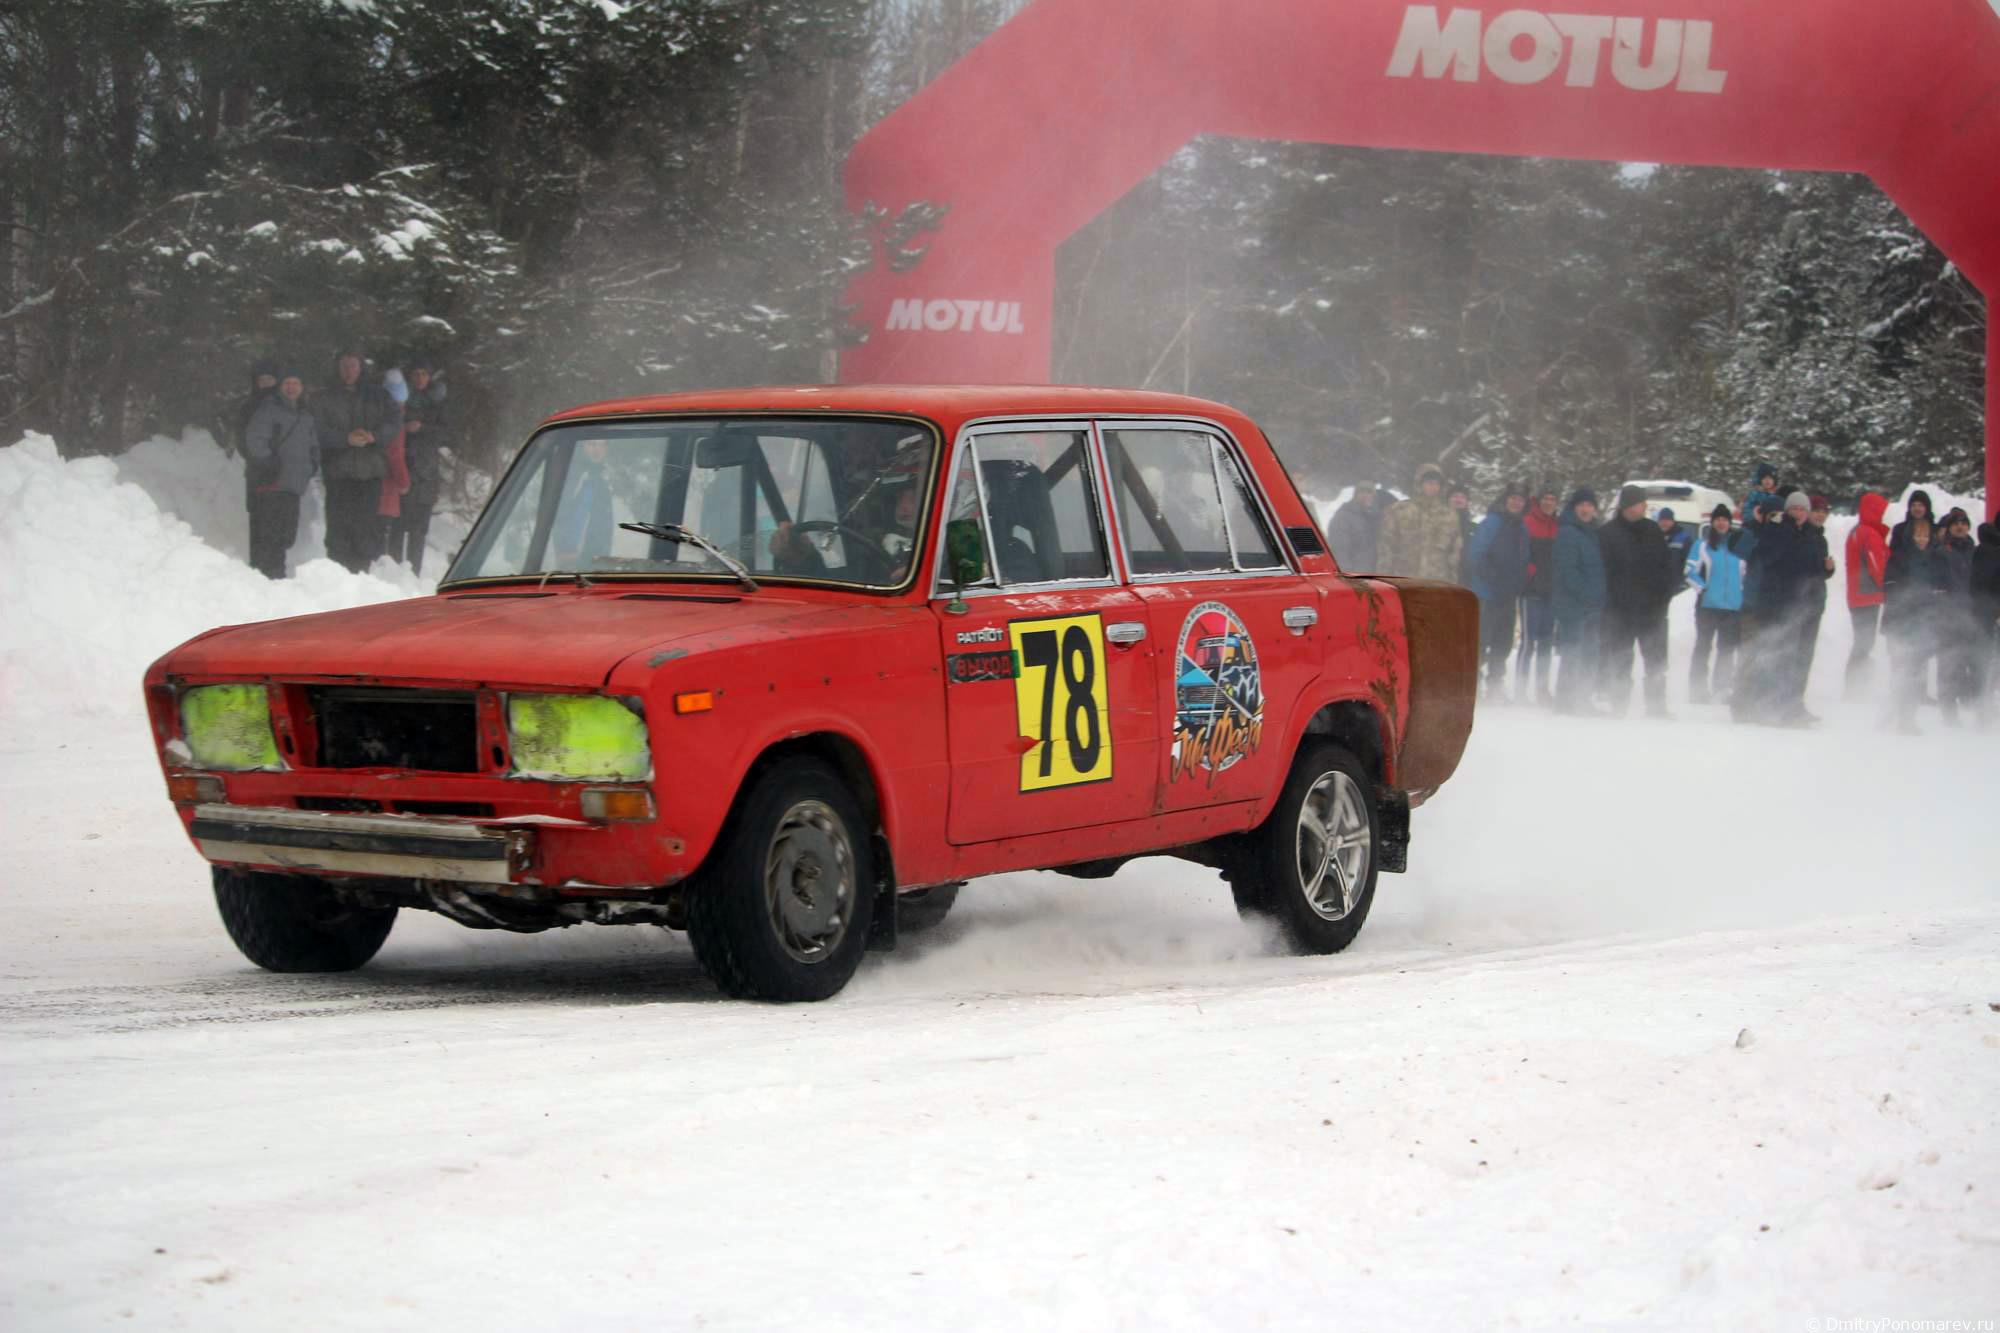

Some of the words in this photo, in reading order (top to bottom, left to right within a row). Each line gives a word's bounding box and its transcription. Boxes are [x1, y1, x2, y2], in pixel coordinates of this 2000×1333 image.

[1385, 5, 1728, 94] MOTUL
[885, 298, 1024, 335] MOTUL
[957, 628, 1004, 643] PATRIOT
[1020, 625, 1100, 777] 78
